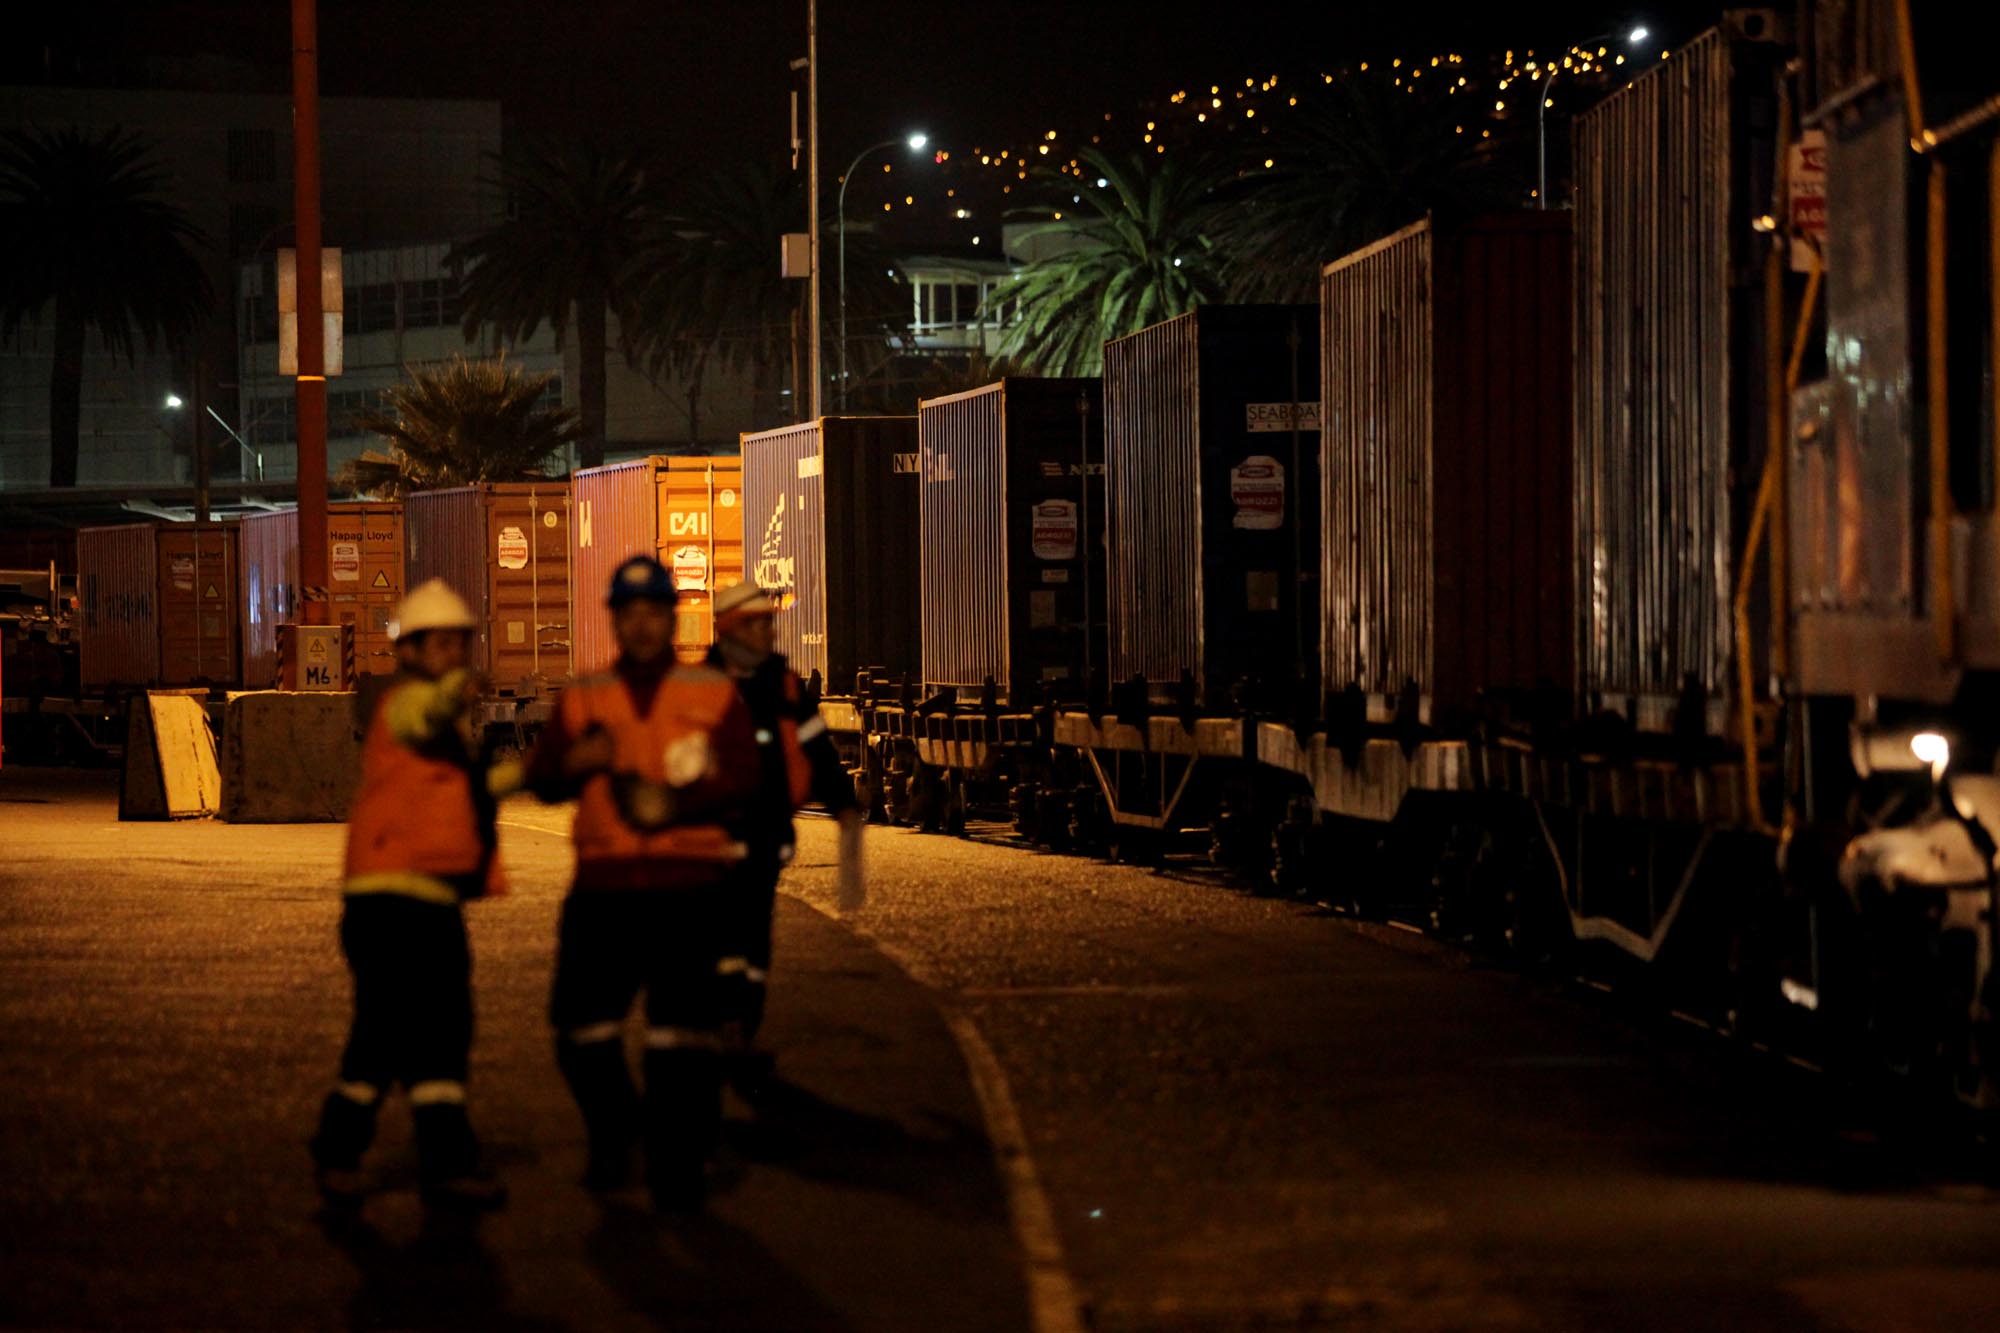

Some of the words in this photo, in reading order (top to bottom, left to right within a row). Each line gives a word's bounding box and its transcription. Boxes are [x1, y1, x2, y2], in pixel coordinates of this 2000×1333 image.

[670, 512, 707, 535] CAI
[330, 531, 363, 542] Hapag
[367, 531, 393, 541] Lloyd
[306, 666, 330, 685] M6
